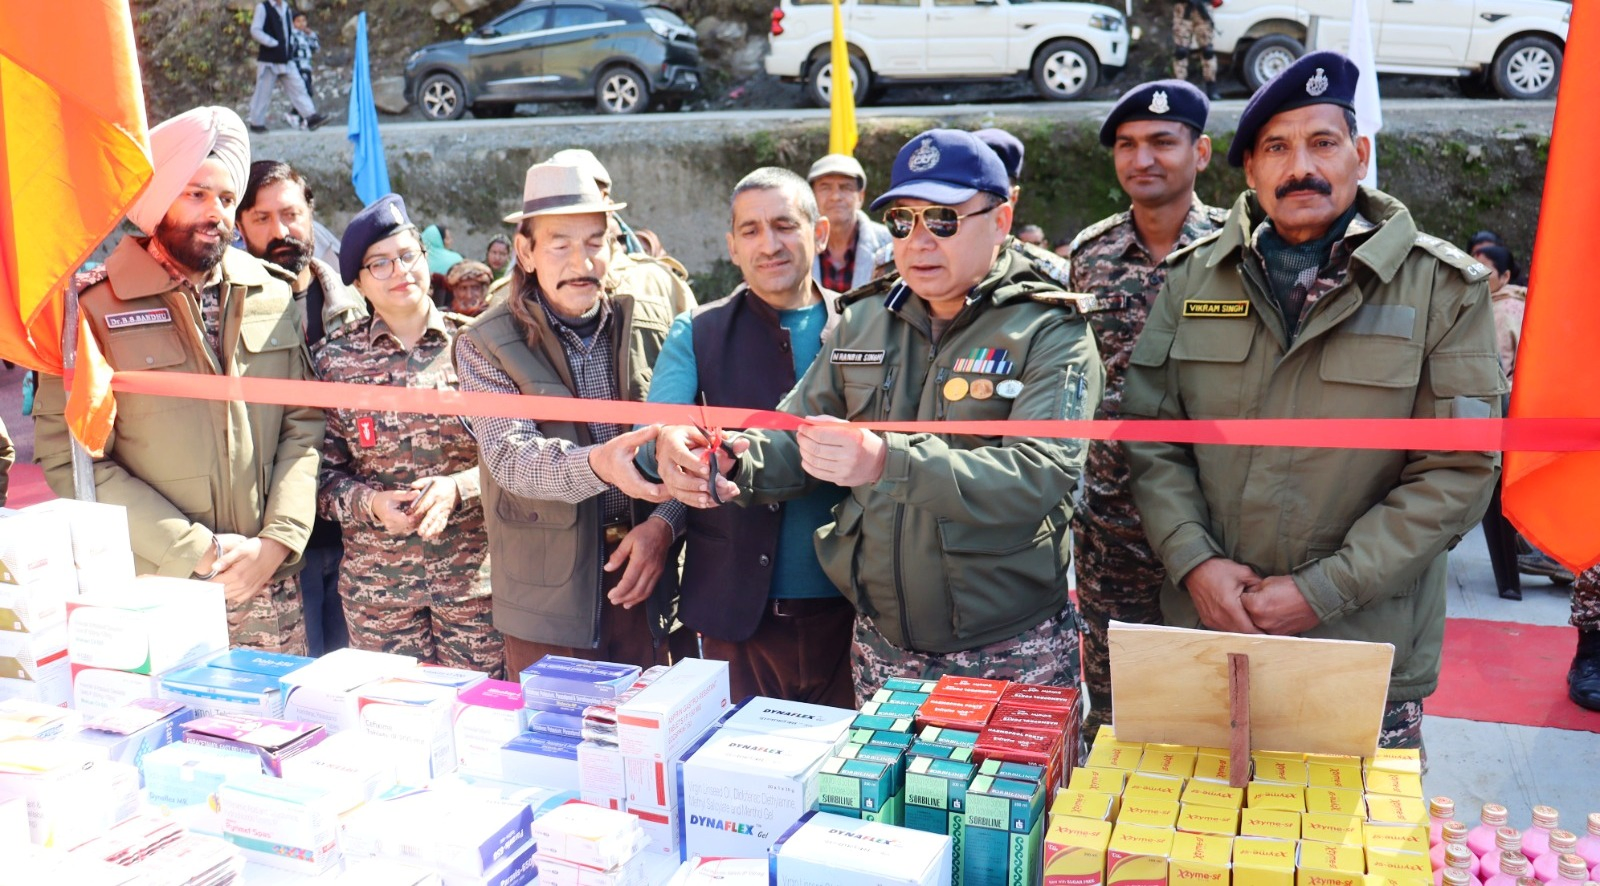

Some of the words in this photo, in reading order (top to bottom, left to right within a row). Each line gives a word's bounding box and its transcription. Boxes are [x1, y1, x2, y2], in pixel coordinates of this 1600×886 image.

[1189, 304, 1220, 312] VIKRAM
[1221, 304, 1244, 312] SINGH
[762, 708, 815, 720] DYNAFLEX
[727, 741, 784, 755] DYNAFLEX
[841, 769, 879, 778] SORBILINE
[929, 769, 967, 778] SORBILINE
[1131, 784, 1174, 794] Xzyme-sf
[1191, 788, 1233, 799] Xzyme-sf
[822, 793, 853, 807] SORBILINE
[909, 793, 940, 807] SORBILINE
[1254, 792, 1297, 800] Xzyme-sf
[1128, 806, 1171, 816] Xzyme-sf
[969, 815, 1002, 828] SORBILINE
[1186, 813, 1231, 823] Xzyme-sf
[1250, 818, 1294, 828] Xzyme-sf
[690, 814, 754, 836] DYNAFLEX
[1310, 822, 1354, 833] Xzyme-sf
[757, 830, 769, 839] Gel
[828, 828, 891, 845] DYNAFLEX
[1056, 825, 1101, 838] Xzyme-sf
[1120, 833, 1166, 844] Xzyme-sf
[1372, 834, 1420, 844] Xzyme-sf
[1240, 849, 1287, 858] Xzyme-sf
[1374, 861, 1424, 872] Xzyme-sf
[1178, 868, 1222, 881] Xzyme-sf
[1308, 875, 1354, 886] Xzyme-sf
